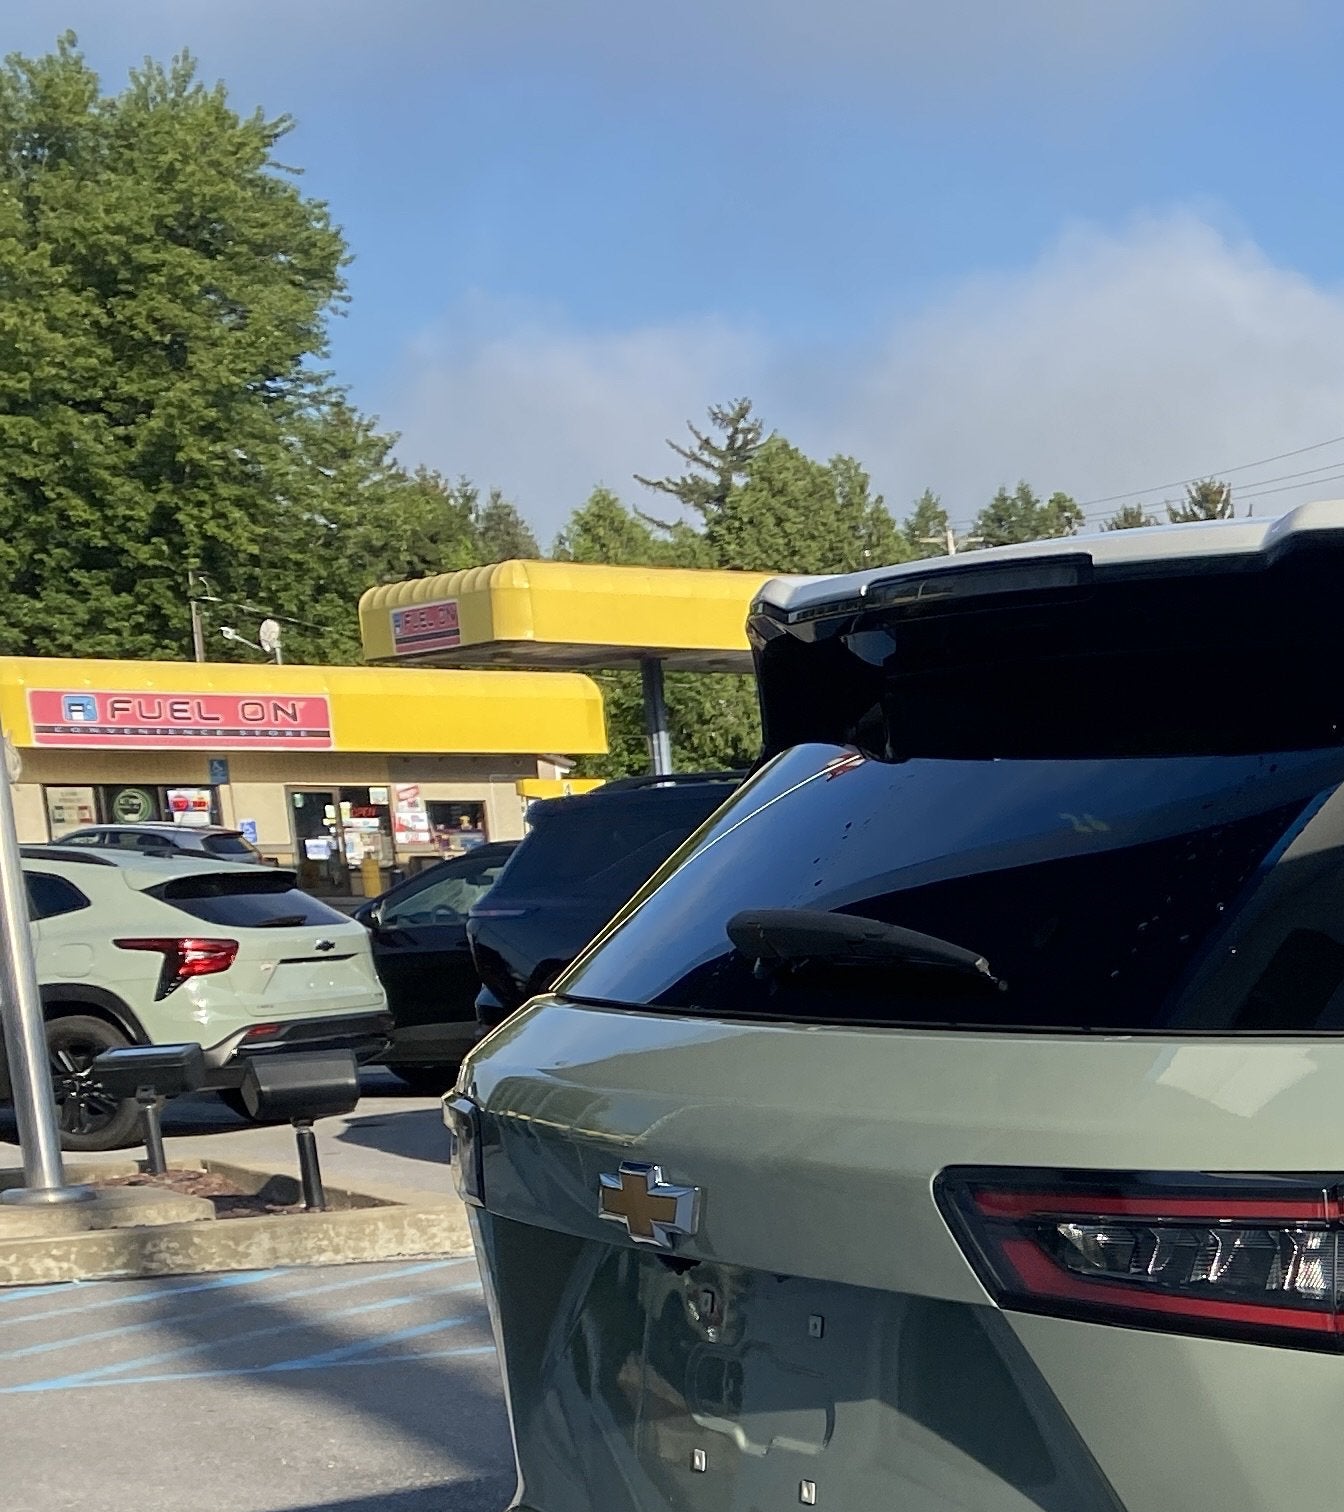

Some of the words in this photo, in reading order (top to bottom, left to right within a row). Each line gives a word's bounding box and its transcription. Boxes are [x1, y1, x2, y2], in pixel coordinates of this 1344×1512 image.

[109, 699, 221, 722] FUEL
[240, 701, 299, 723] ON
[54, 726, 223, 737] CONVENIENCE
[239, 729, 307, 737] STORE
